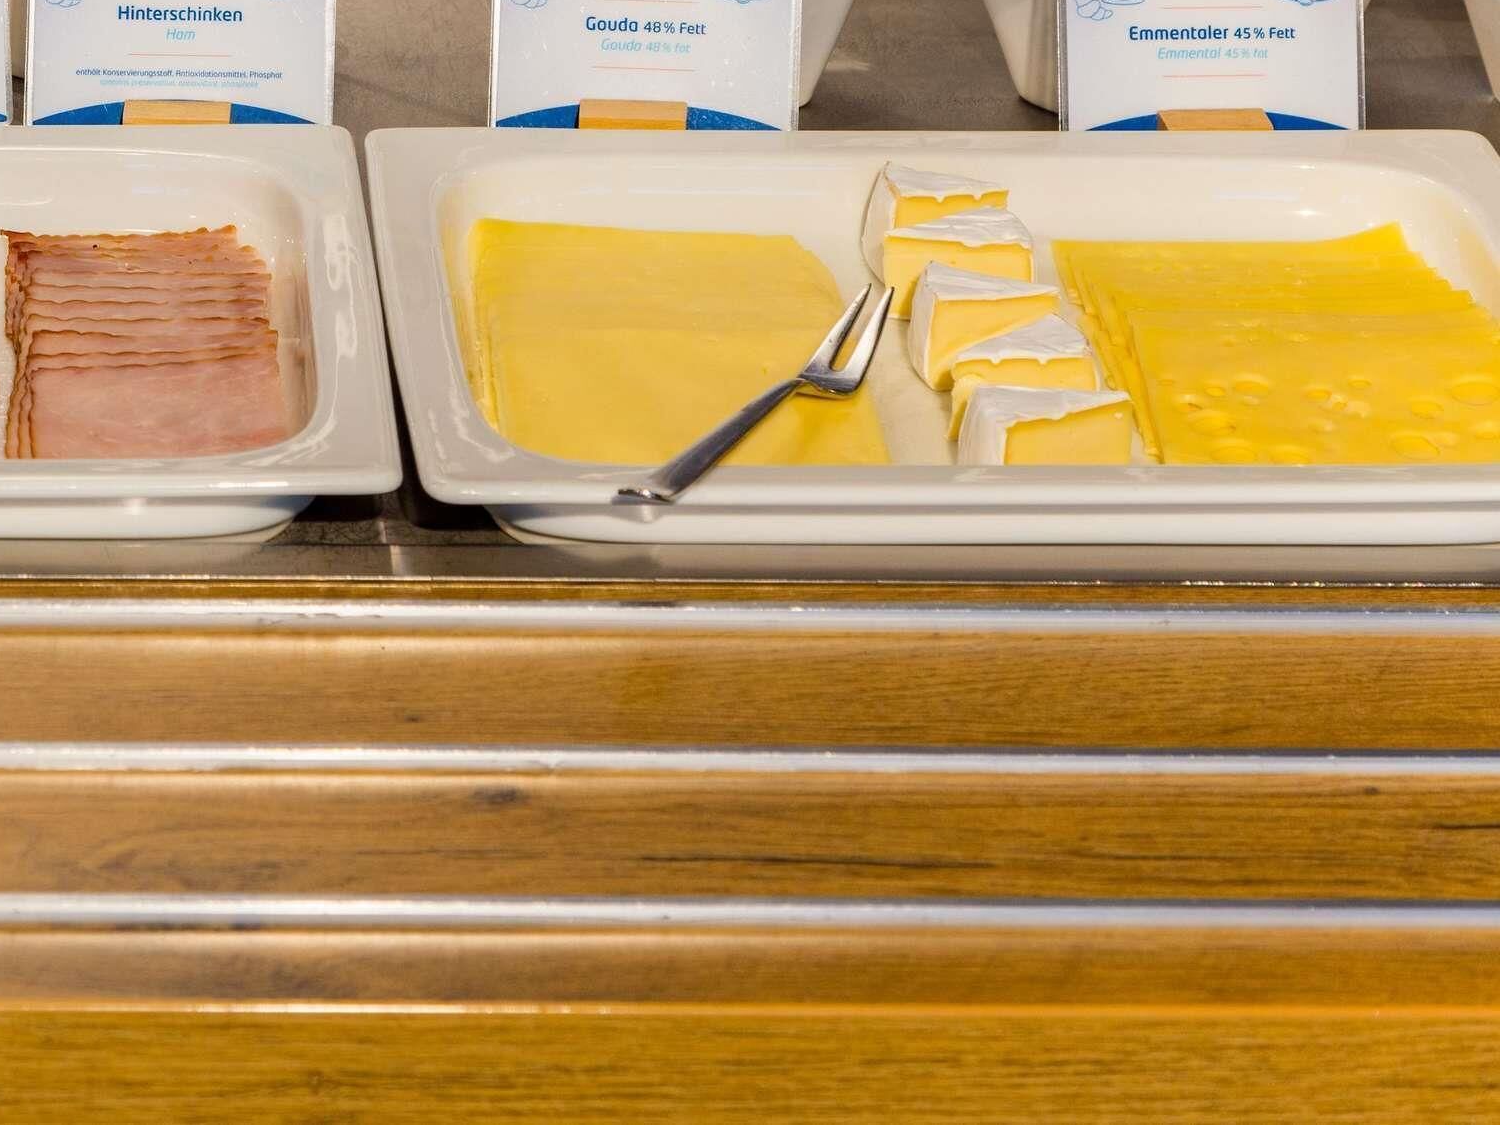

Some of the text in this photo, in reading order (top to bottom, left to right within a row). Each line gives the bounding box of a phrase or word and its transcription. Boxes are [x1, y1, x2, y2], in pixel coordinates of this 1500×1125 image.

[117, 5, 243, 22] Hinterschinken
[586, 16, 638, 32] Gouda
[679, 22, 706, 35] Fett
[1129, 25, 1228, 40] Emmentaler
[1269, 27, 1296, 39] Fett
[165, 28, 196, 41] Ham
[600, 38, 641, 52] Gouda
[1157, 47, 1221, 60] Emmental
